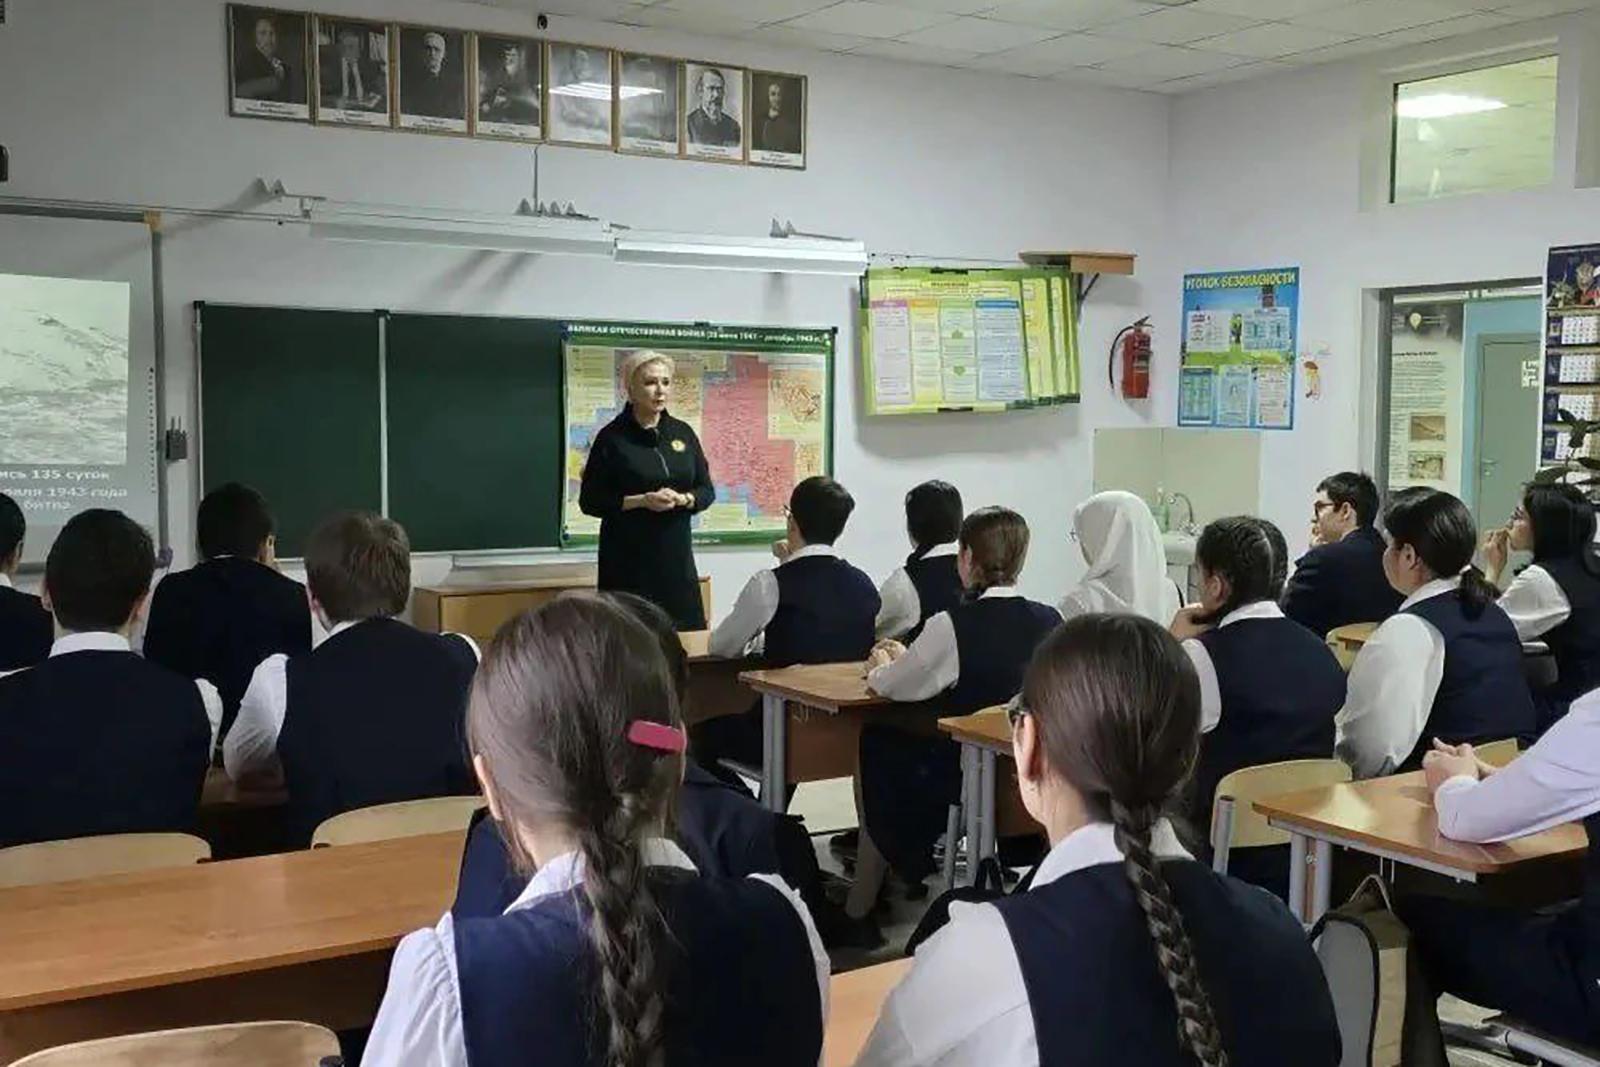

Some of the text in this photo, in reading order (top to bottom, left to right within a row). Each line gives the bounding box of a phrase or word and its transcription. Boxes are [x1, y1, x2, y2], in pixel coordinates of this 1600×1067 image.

[1186, 271, 1296, 290] УГОЛОК БЕЗОПАСНОСТИ
[677, 327, 705, 338] ВОЙНА
[31, 469, 61, 480] 135
[65, 470, 110, 482] суток
